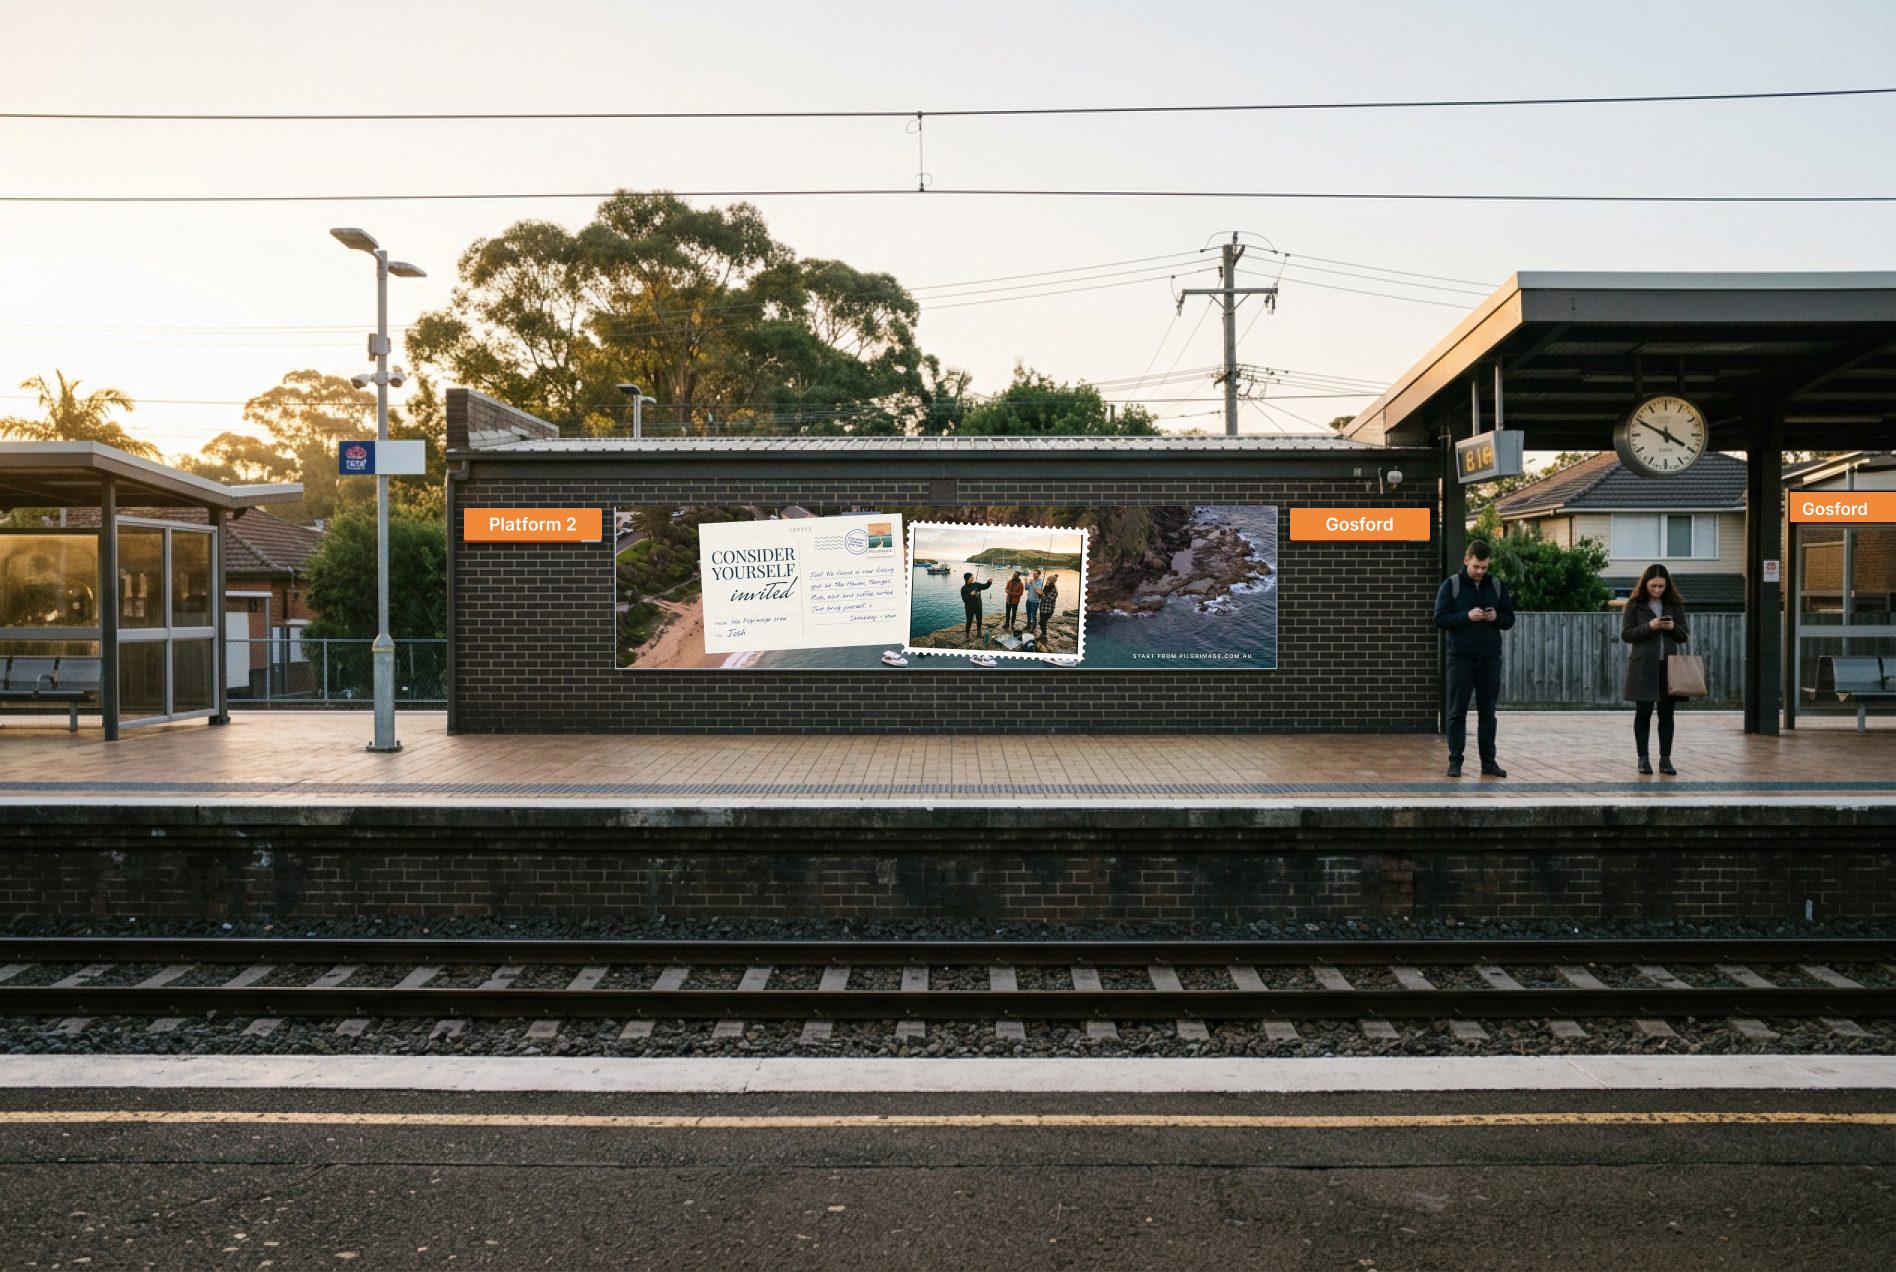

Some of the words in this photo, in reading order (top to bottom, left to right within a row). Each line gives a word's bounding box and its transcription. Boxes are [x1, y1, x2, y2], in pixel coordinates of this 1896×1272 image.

[1802, 501, 1868, 516] Gosford
[489, 516, 561, 531] Platform
[566, 517, 577, 531] 2
[1325, 516, 1394, 531] Gosford
[711, 547, 796, 565] CONSIDER
[711, 563, 796, 581] YOURSELF
[730, 576, 799, 602] invited
[727, 628, 746, 638] Josh
